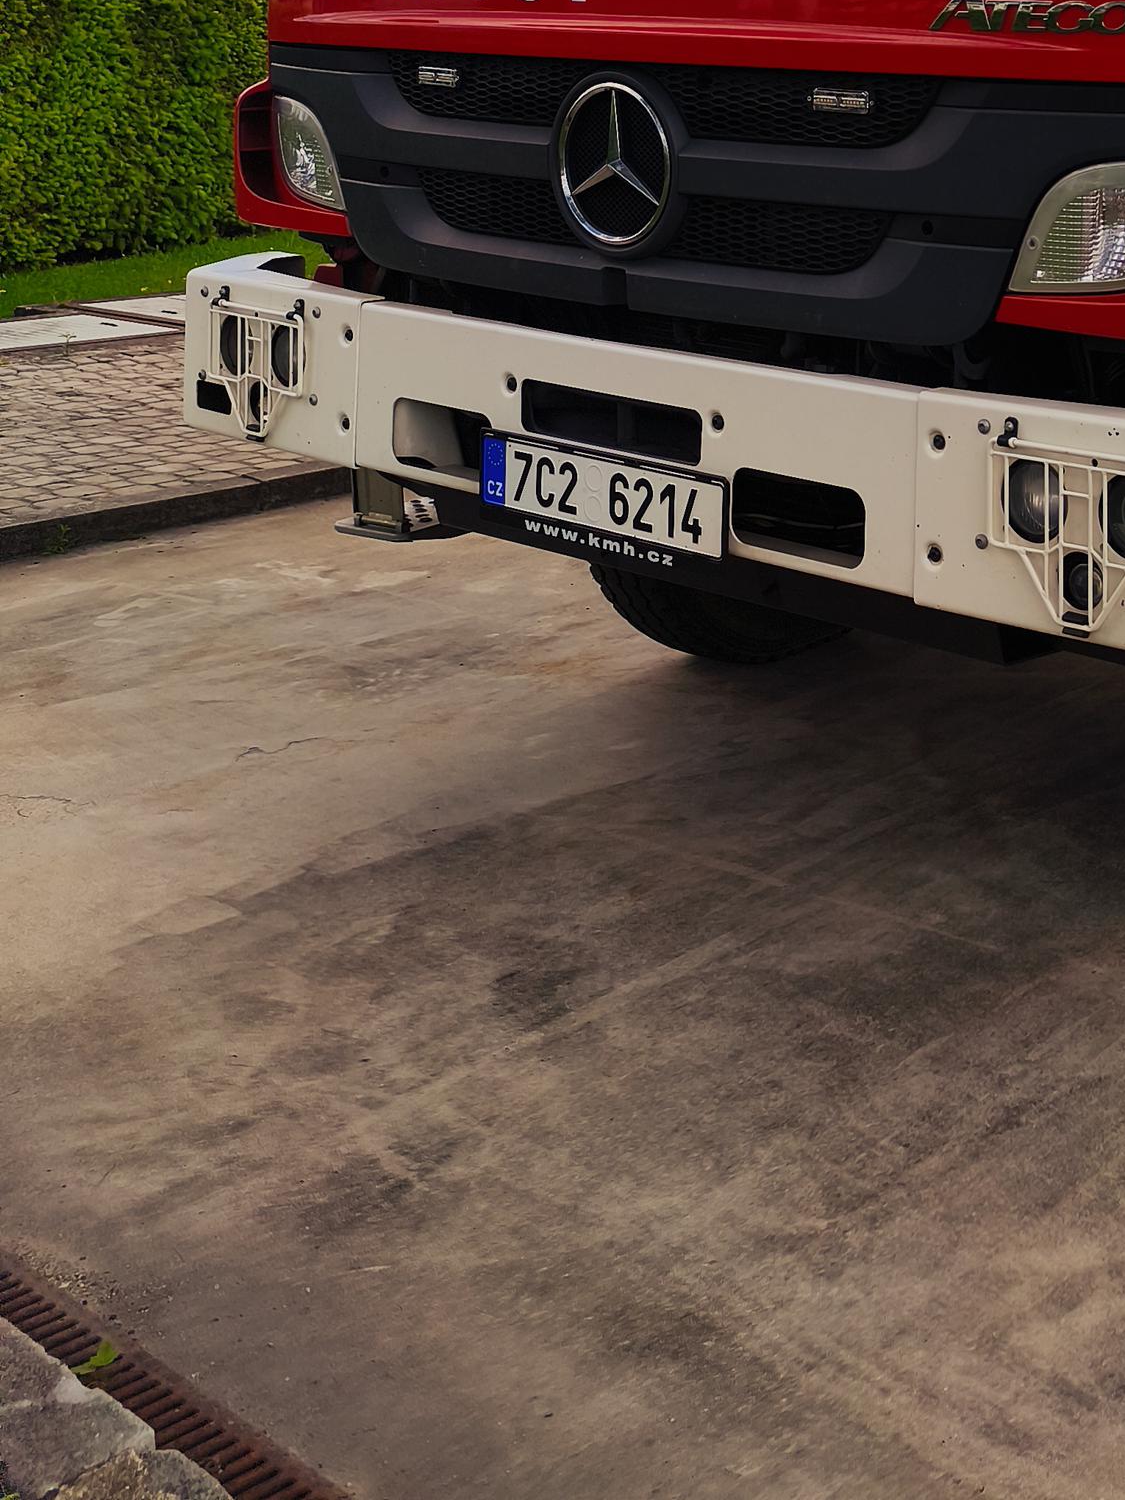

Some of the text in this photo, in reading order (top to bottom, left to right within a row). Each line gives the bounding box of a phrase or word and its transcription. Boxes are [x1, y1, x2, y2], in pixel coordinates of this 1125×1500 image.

[487, 480, 503, 497] CZ
[513, 450, 702, 544] 7C2 6214
[524, 519, 673, 567] www.kmh.cz
